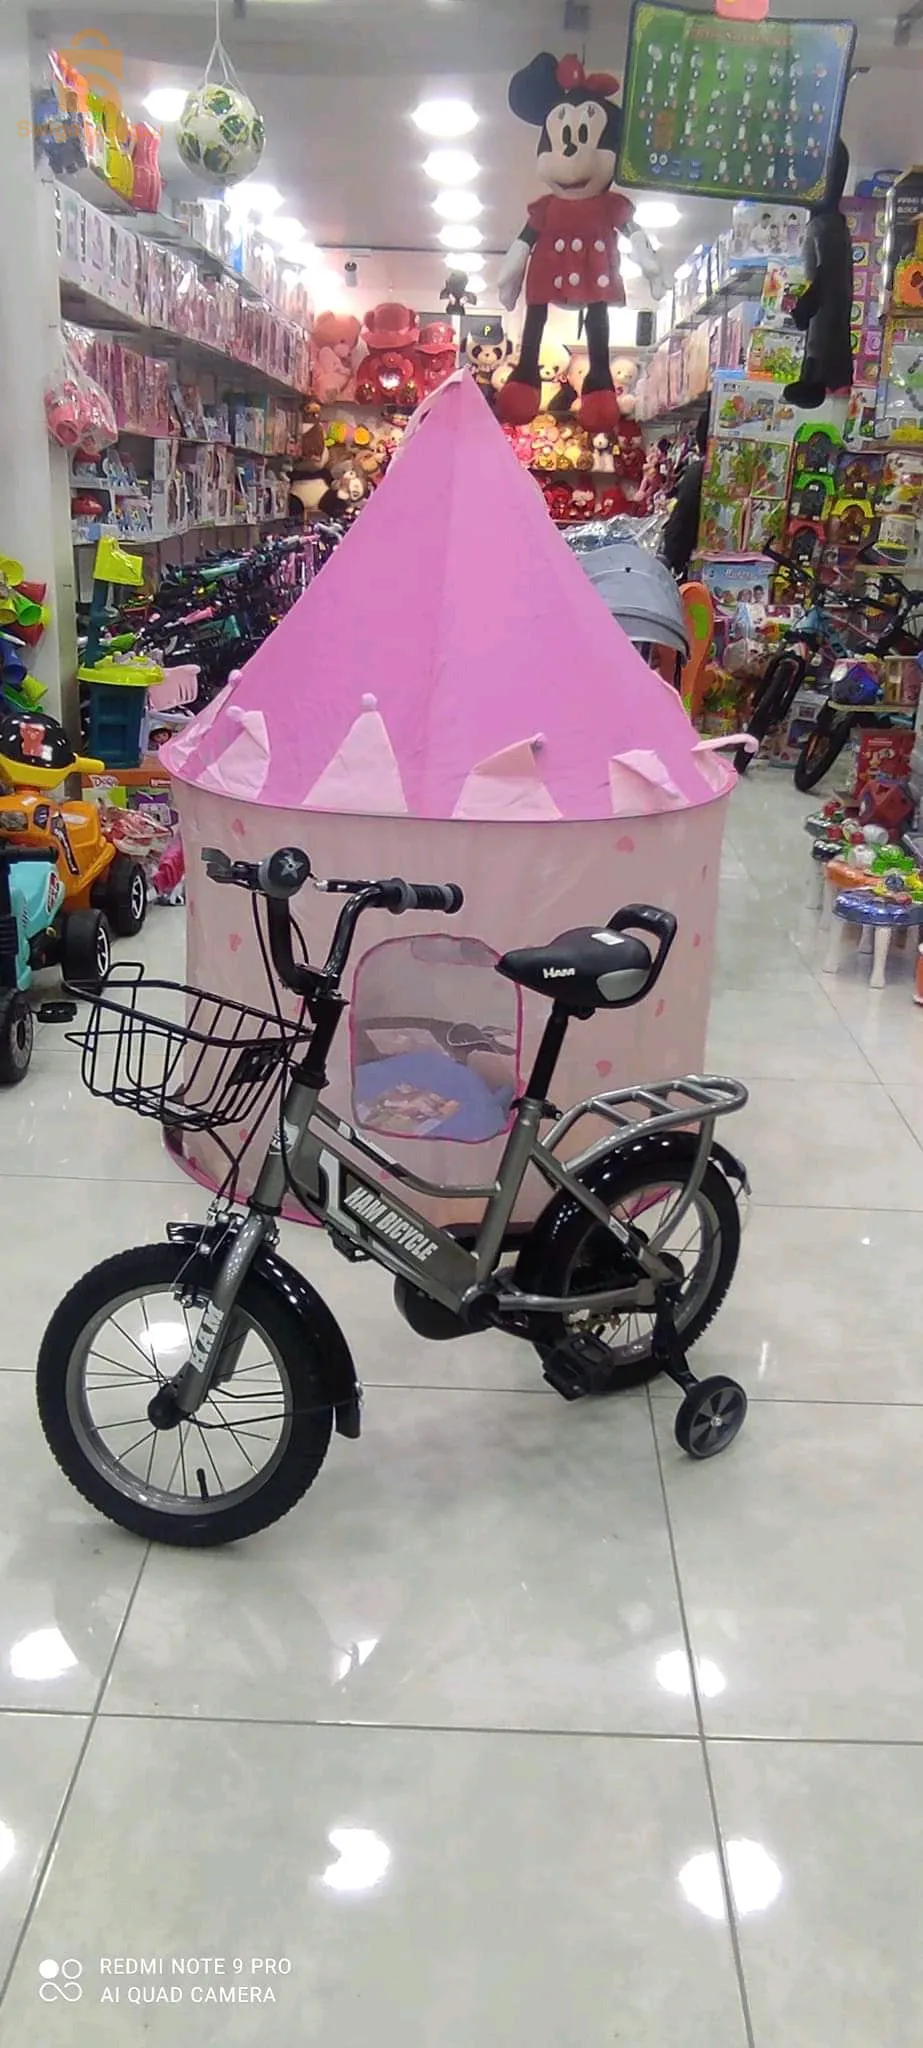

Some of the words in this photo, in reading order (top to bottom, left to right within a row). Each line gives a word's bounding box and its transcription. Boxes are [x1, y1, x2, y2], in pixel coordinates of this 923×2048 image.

[344, 1186, 388, 1223] HAM
[375, 1210, 439, 1261] BICYCLE
[190, 1300, 224, 1373] HAM
